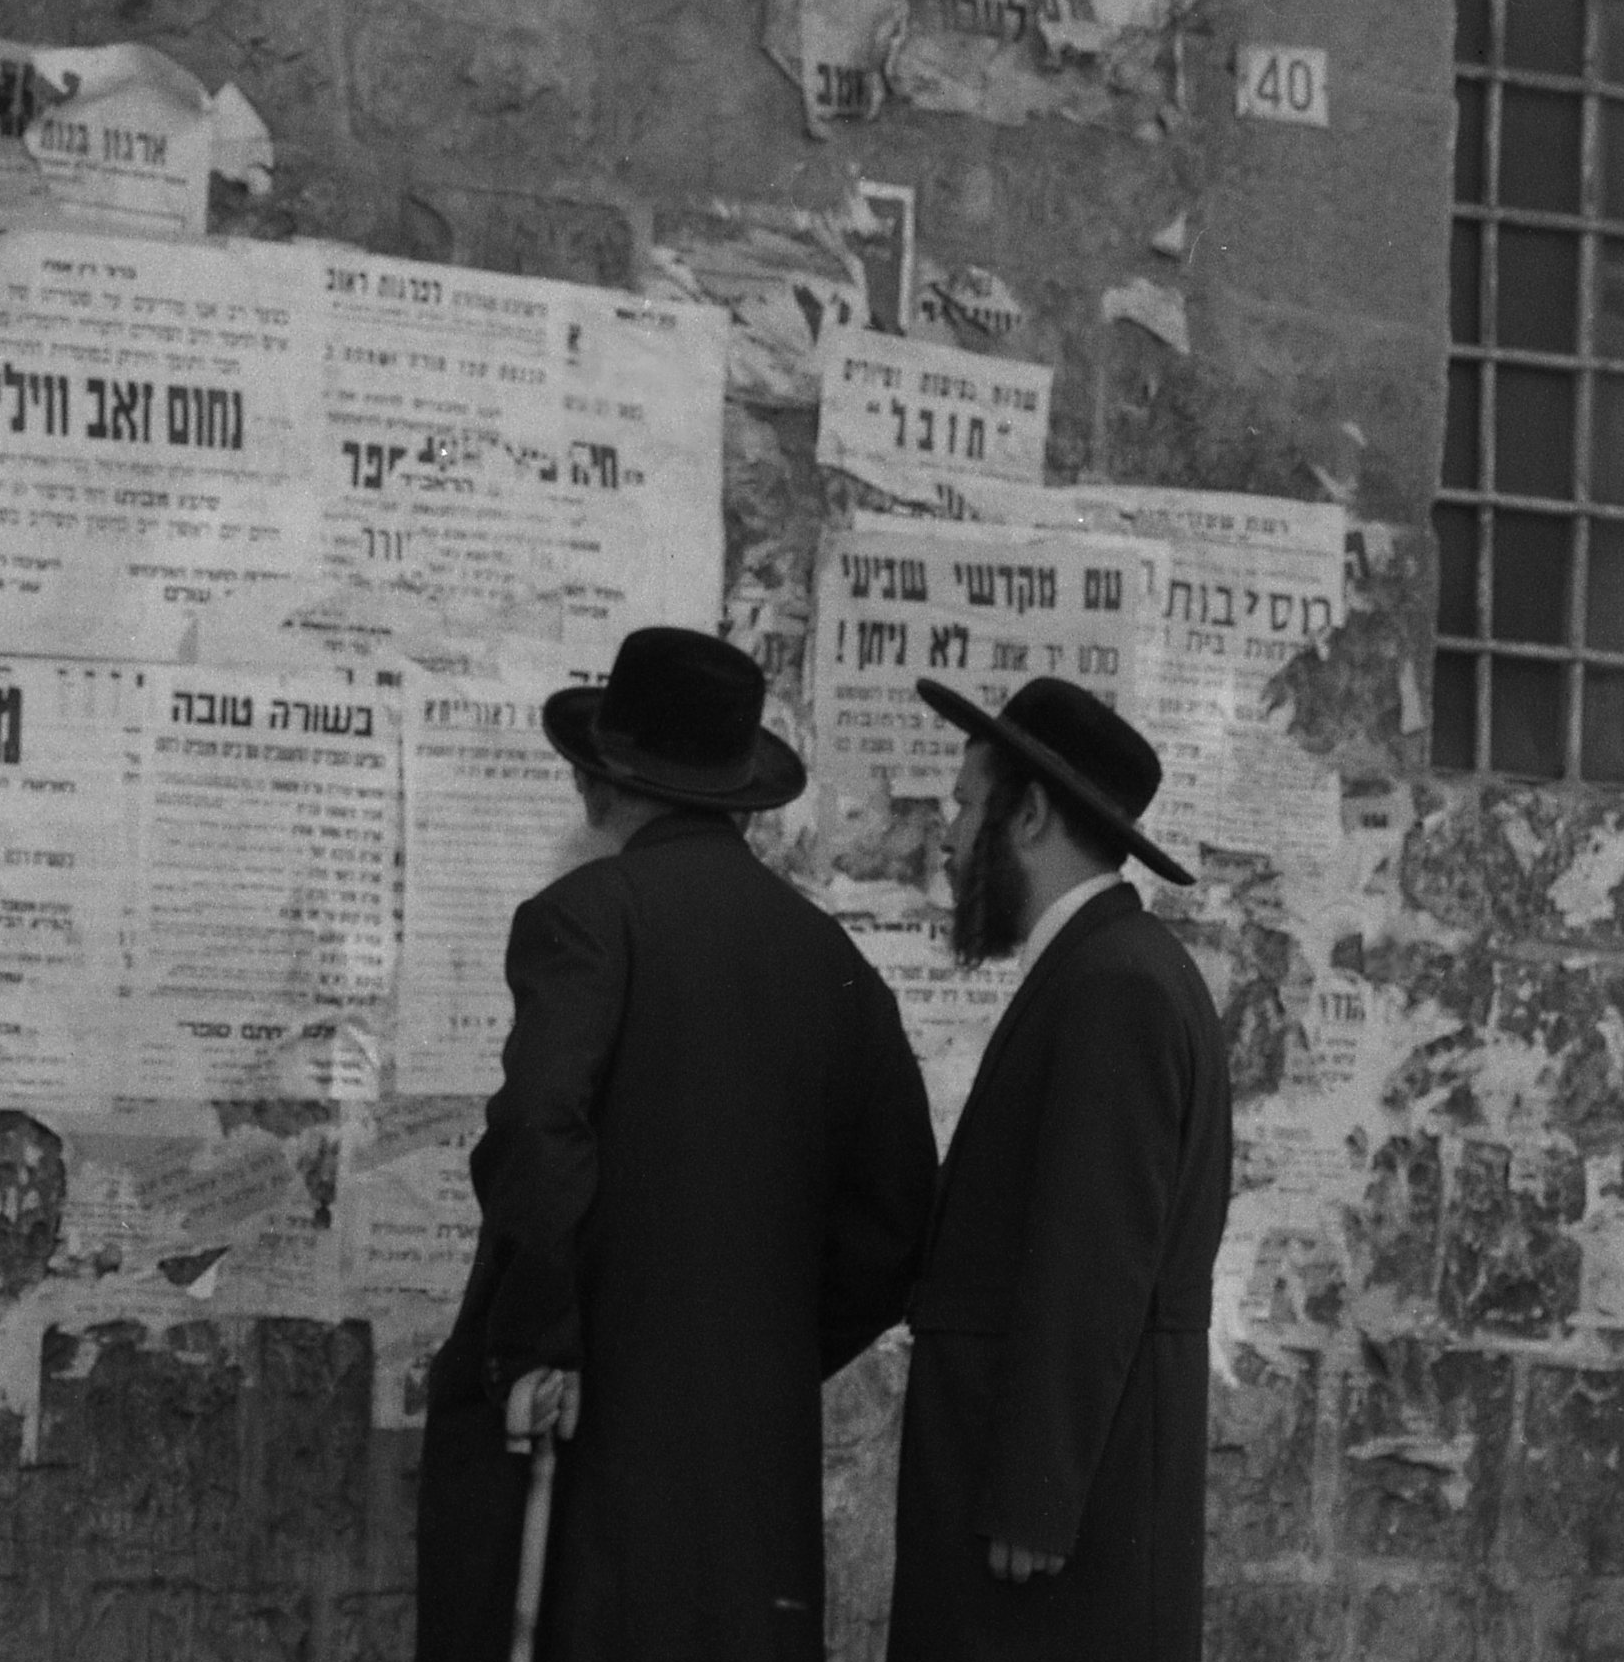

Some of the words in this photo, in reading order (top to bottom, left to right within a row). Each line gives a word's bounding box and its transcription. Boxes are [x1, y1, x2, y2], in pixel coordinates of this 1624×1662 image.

[1255, 57, 1314, 112] 40
[84, 376, 155, 444] זאב
[166, 383, 245, 451] נחום
[953, 561, 1057, 615] מקדשי
[929, 622, 970, 668] לא
[171, 691, 254, 728] טובה
[268, 698, 373, 737] בשורה
